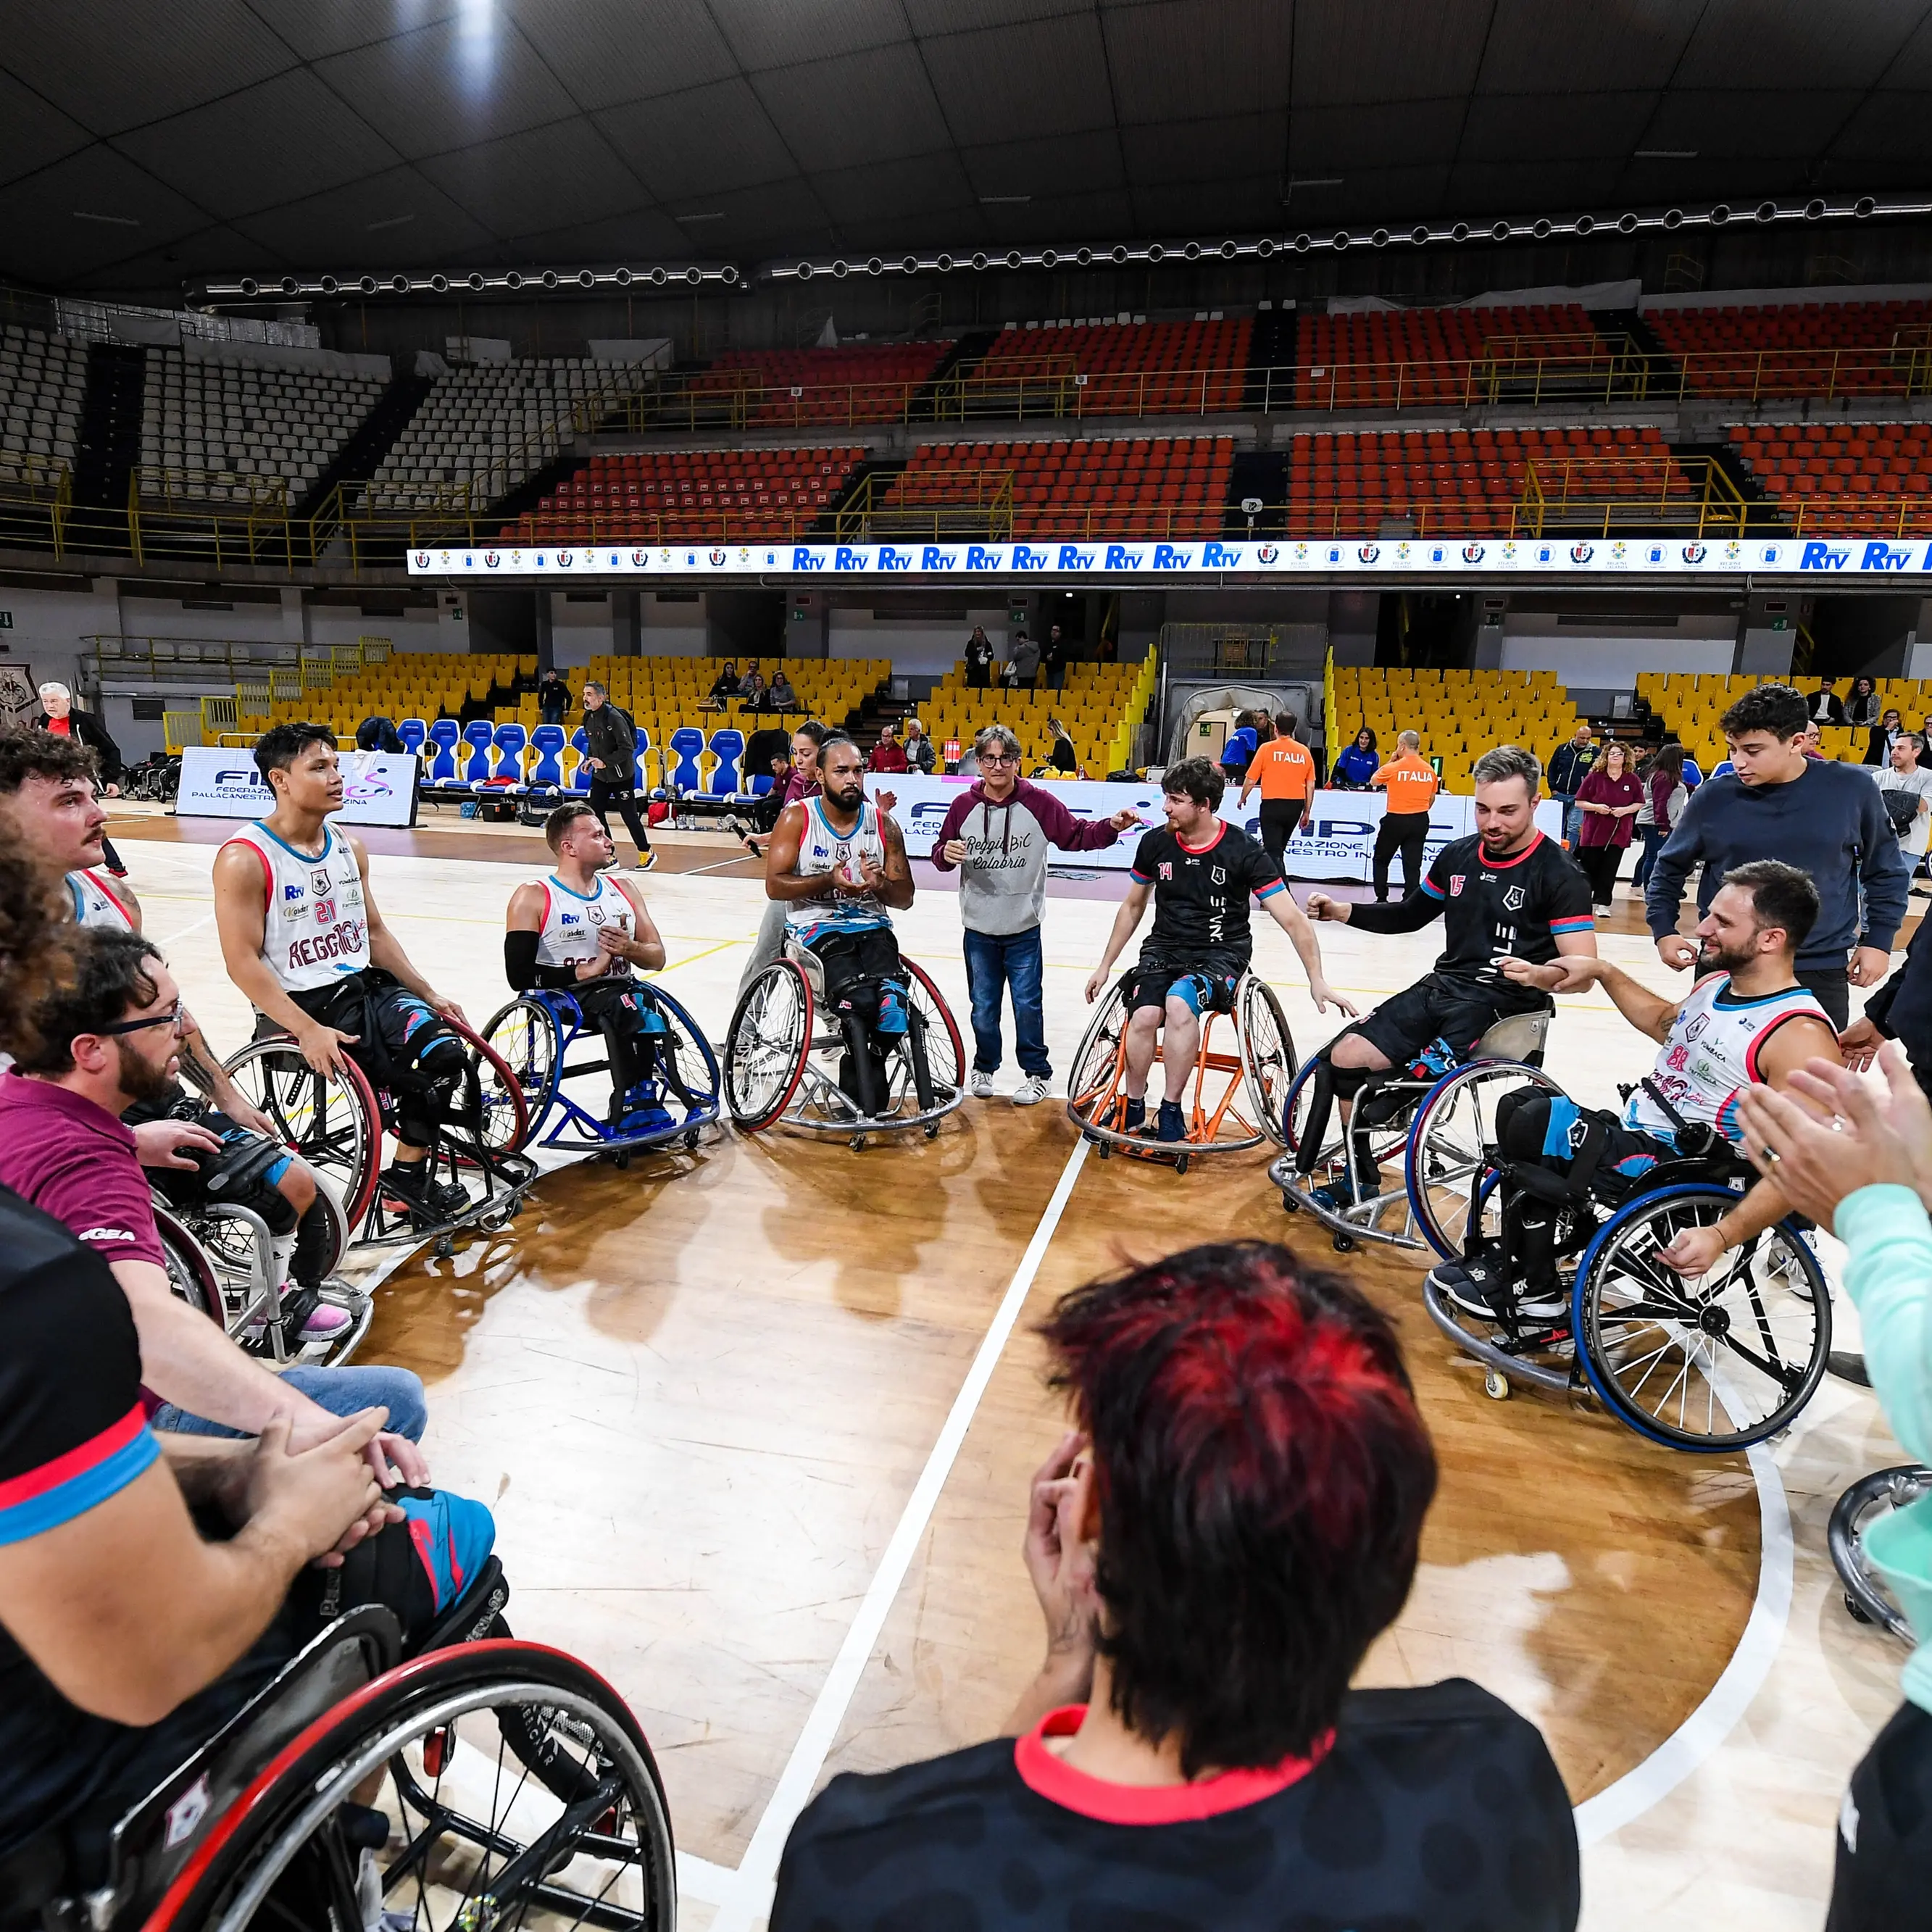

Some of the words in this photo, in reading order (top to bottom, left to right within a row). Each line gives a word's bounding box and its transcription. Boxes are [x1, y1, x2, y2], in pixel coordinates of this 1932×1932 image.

[1273, 751, 1306, 765] ITALIA
[1397, 770, 1433, 783] ITALIA
[973, 856, 1027, 870] Calabria
[1158, 862, 1173, 880] 14
[1450, 875, 1466, 897] 15
[313, 898, 337, 925] 21
[289, 920, 362, 970] REGGIO
[620, 994, 637, 1010] 4
